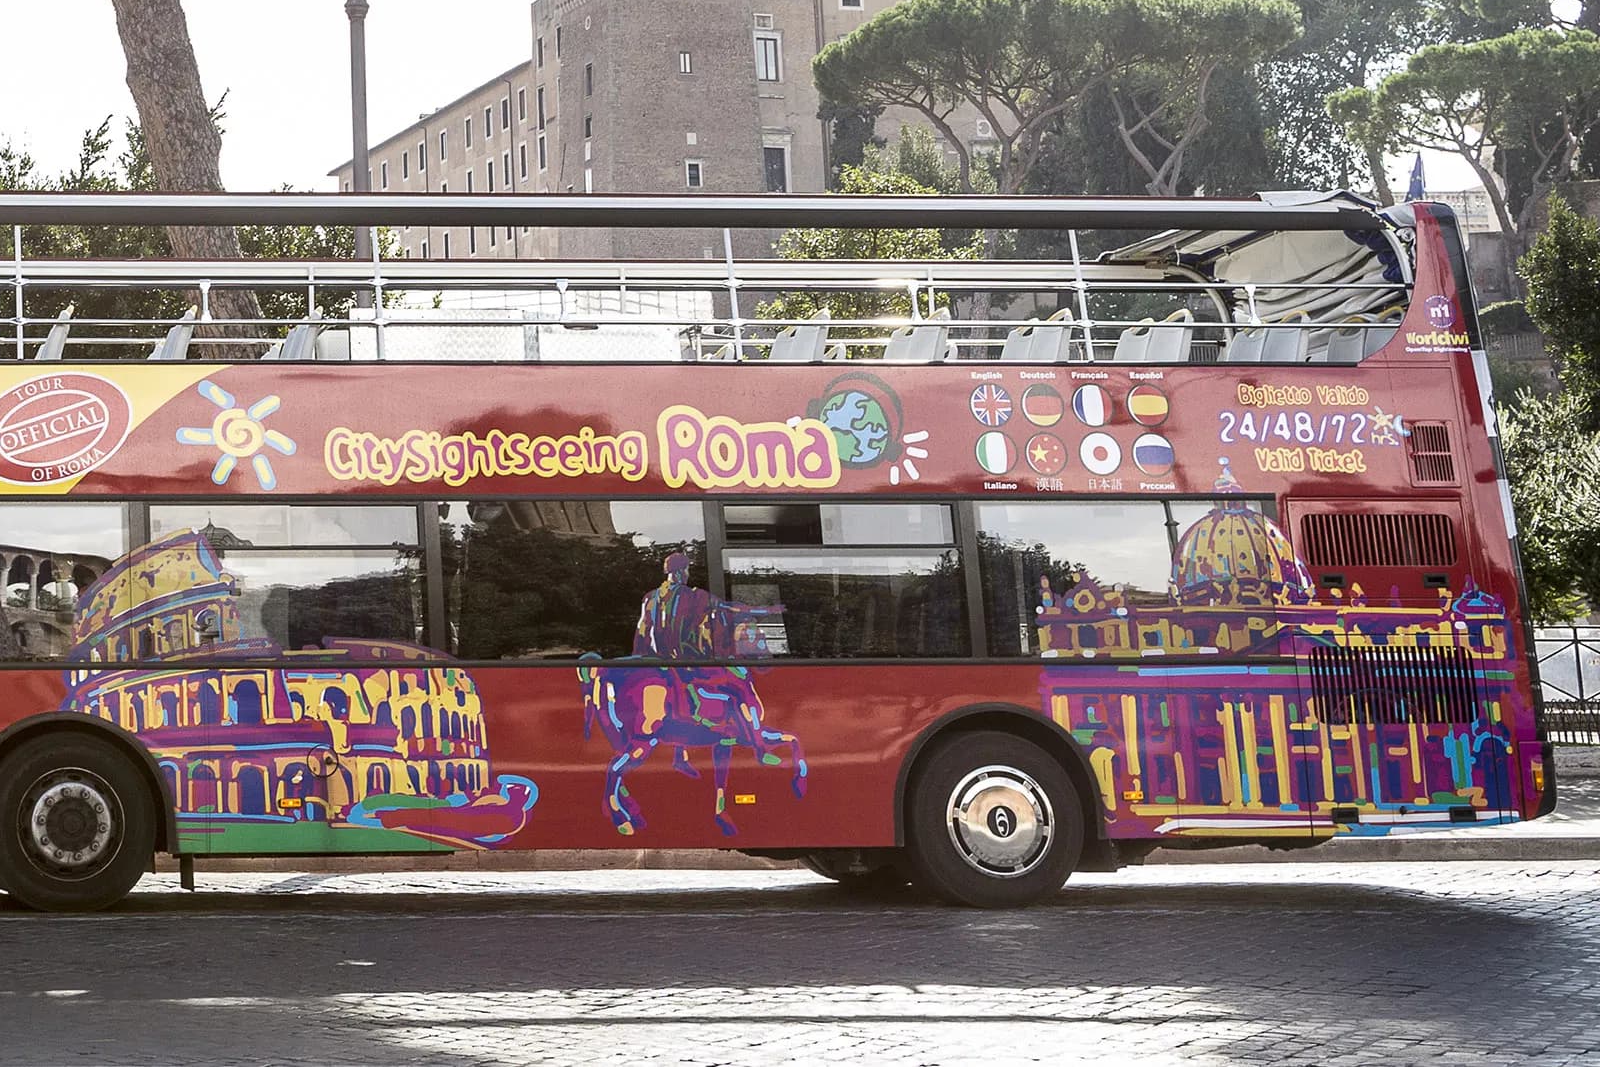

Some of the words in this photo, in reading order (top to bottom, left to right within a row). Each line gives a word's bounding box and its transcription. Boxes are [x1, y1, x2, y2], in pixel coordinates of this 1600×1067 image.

[13, 377, 64, 401] TOUR
[971, 371, 1002, 380] English
[1020, 371, 1056, 380] Deutsch
[1071, 371, 1108, 381] Français
[1129, 371, 1163, 380] Español
[1238, 383, 1312, 408] Biglietto
[1316, 385, 1369, 405] Valido
[0, 407, 104, 450] OFFICIAL
[1219, 411, 1366, 443] 24/48/72
[1371, 432, 1399, 445] hrs.
[657, 405, 840, 489] Roma
[1255, 448, 1305, 471] Valid
[1306, 447, 1366, 473] Ticket
[31, 468, 56, 481] OF
[57, 447, 106, 477] ROMA
[984, 481, 1017, 490] Italiano
